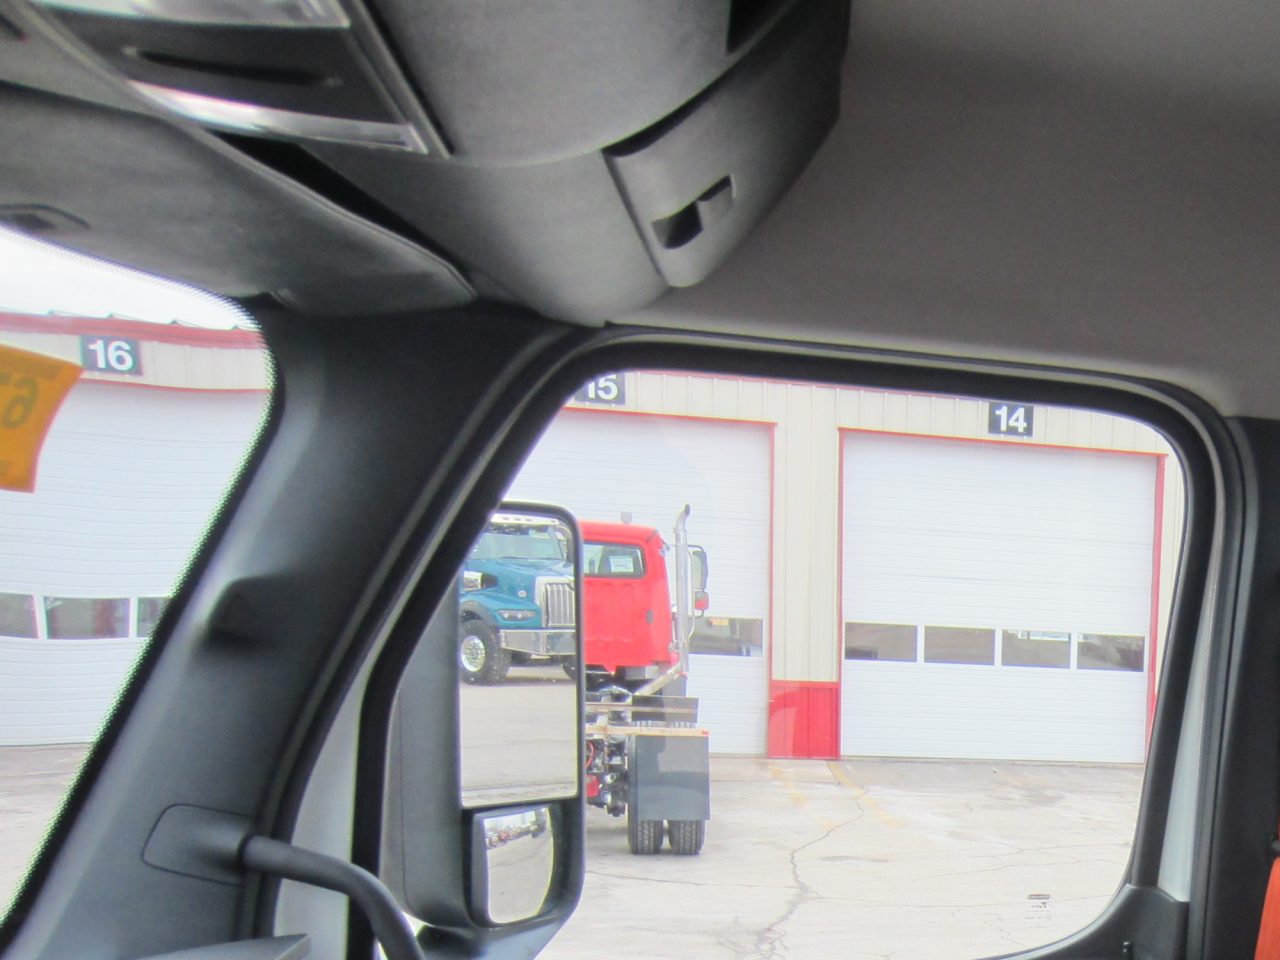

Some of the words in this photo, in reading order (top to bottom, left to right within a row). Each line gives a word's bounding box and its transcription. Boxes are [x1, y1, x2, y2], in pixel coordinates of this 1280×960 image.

[88, 340, 133, 371] 16
[588, 374, 618, 400] 15
[995, 404, 1027, 433] 14
